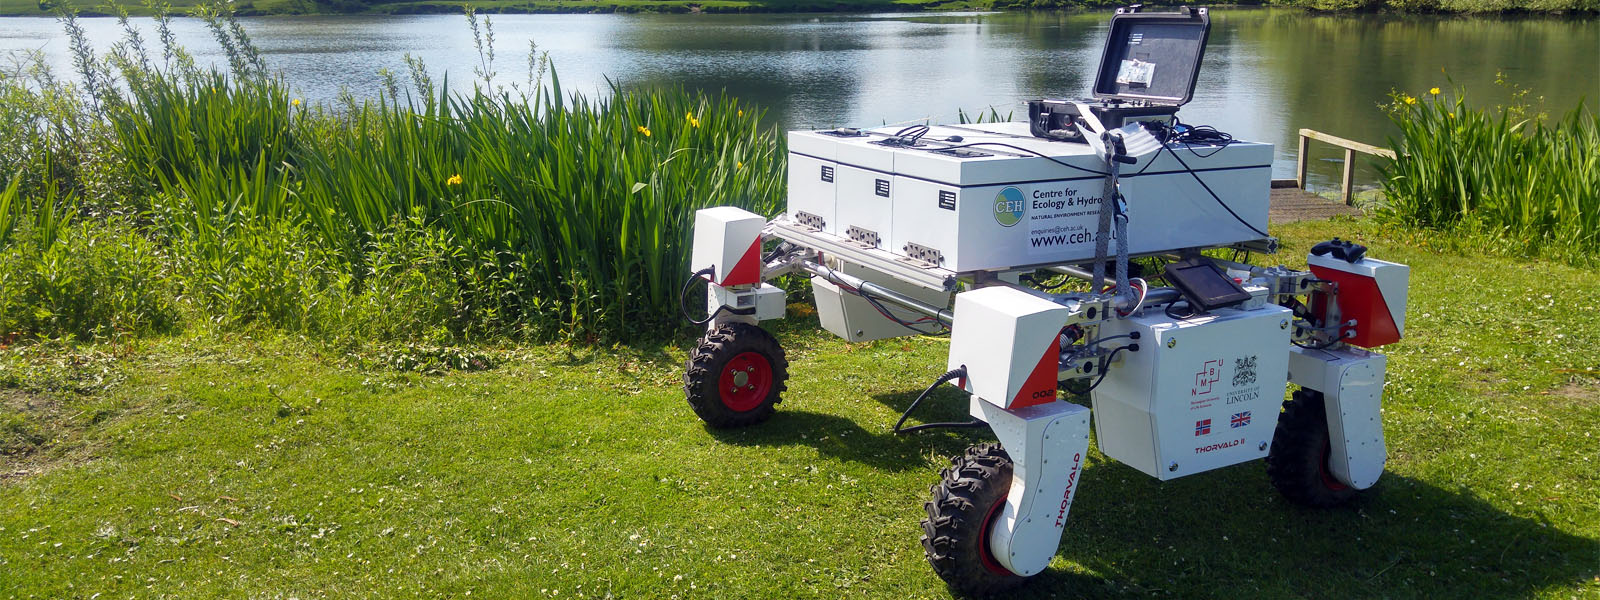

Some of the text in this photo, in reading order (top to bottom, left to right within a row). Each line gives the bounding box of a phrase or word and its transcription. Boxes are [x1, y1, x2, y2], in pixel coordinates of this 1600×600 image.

[1033, 188, 1078, 198] Centre for
[995, 201, 1023, 213] CEH
[1033, 196, 1102, 209] Ecology & Hydro
[1032, 389, 1054, 399] 002
[1226, 392, 1260, 404] LINCOLN
[1195, 440, 1239, 454] THORVALD
[1055, 453, 1081, 527] THORVALD
